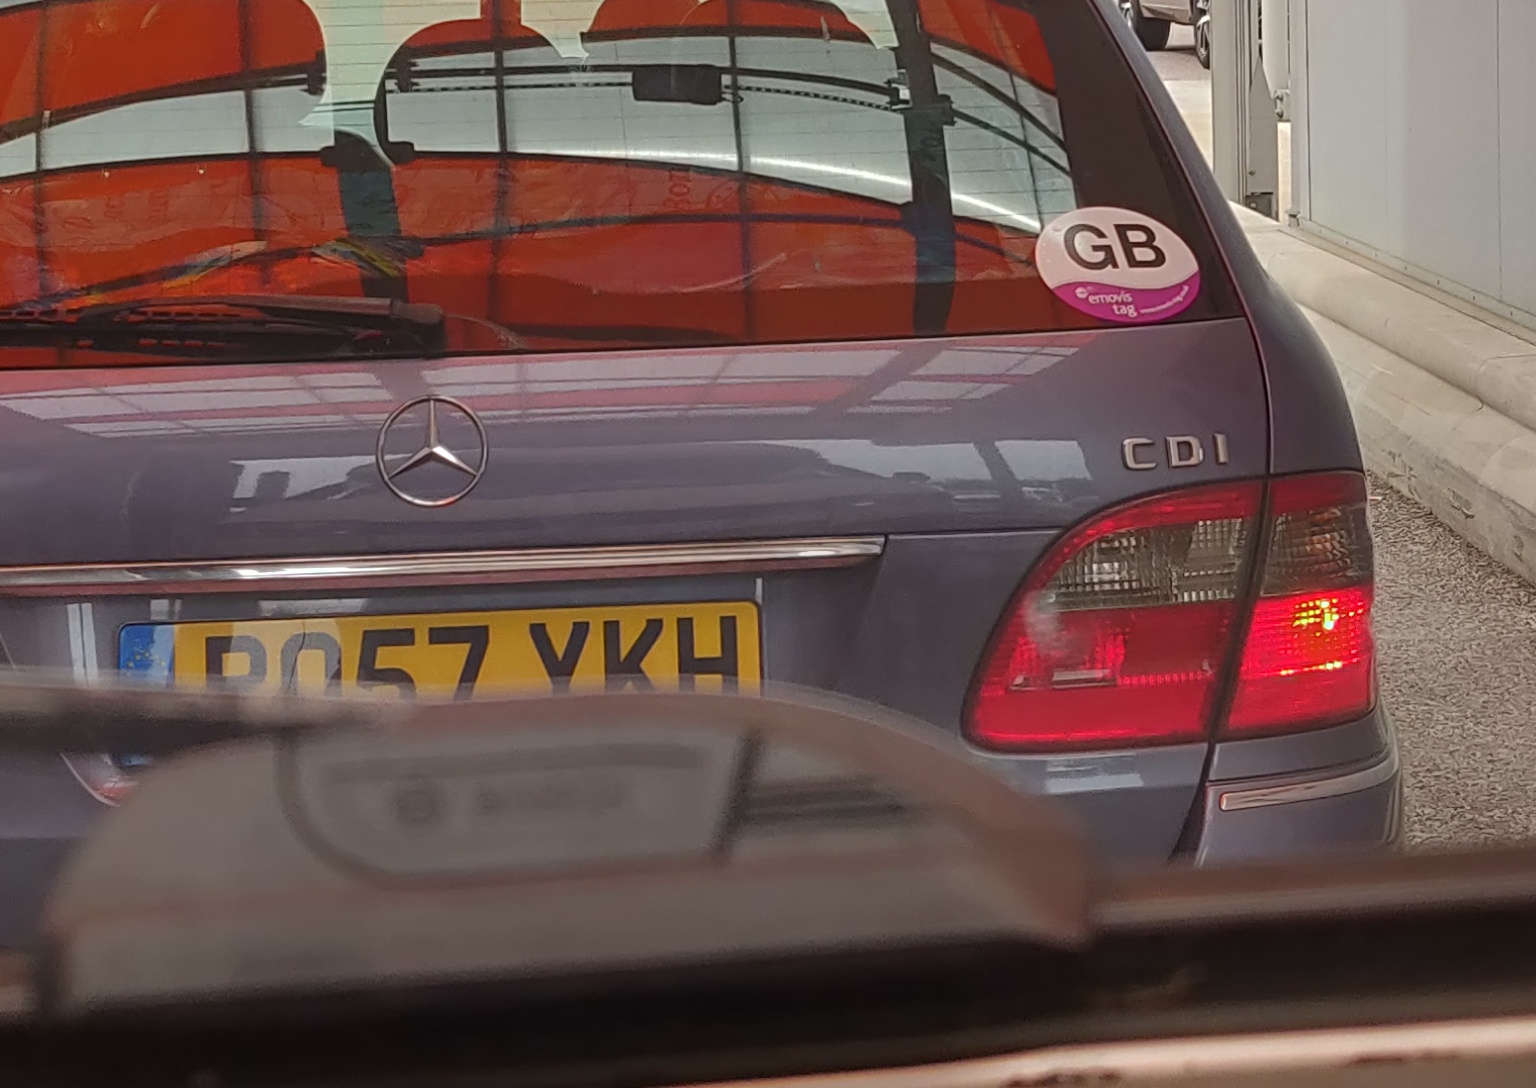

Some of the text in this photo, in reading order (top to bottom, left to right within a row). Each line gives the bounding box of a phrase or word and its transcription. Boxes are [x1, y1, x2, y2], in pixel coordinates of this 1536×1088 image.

[1064, 223, 1166, 271] GB
[1088, 290, 1133, 305] emovis
[1112, 304, 1138, 318] tag
[1122, 433, 1230, 470] CDI
[530, 615, 738, 696] YKH
